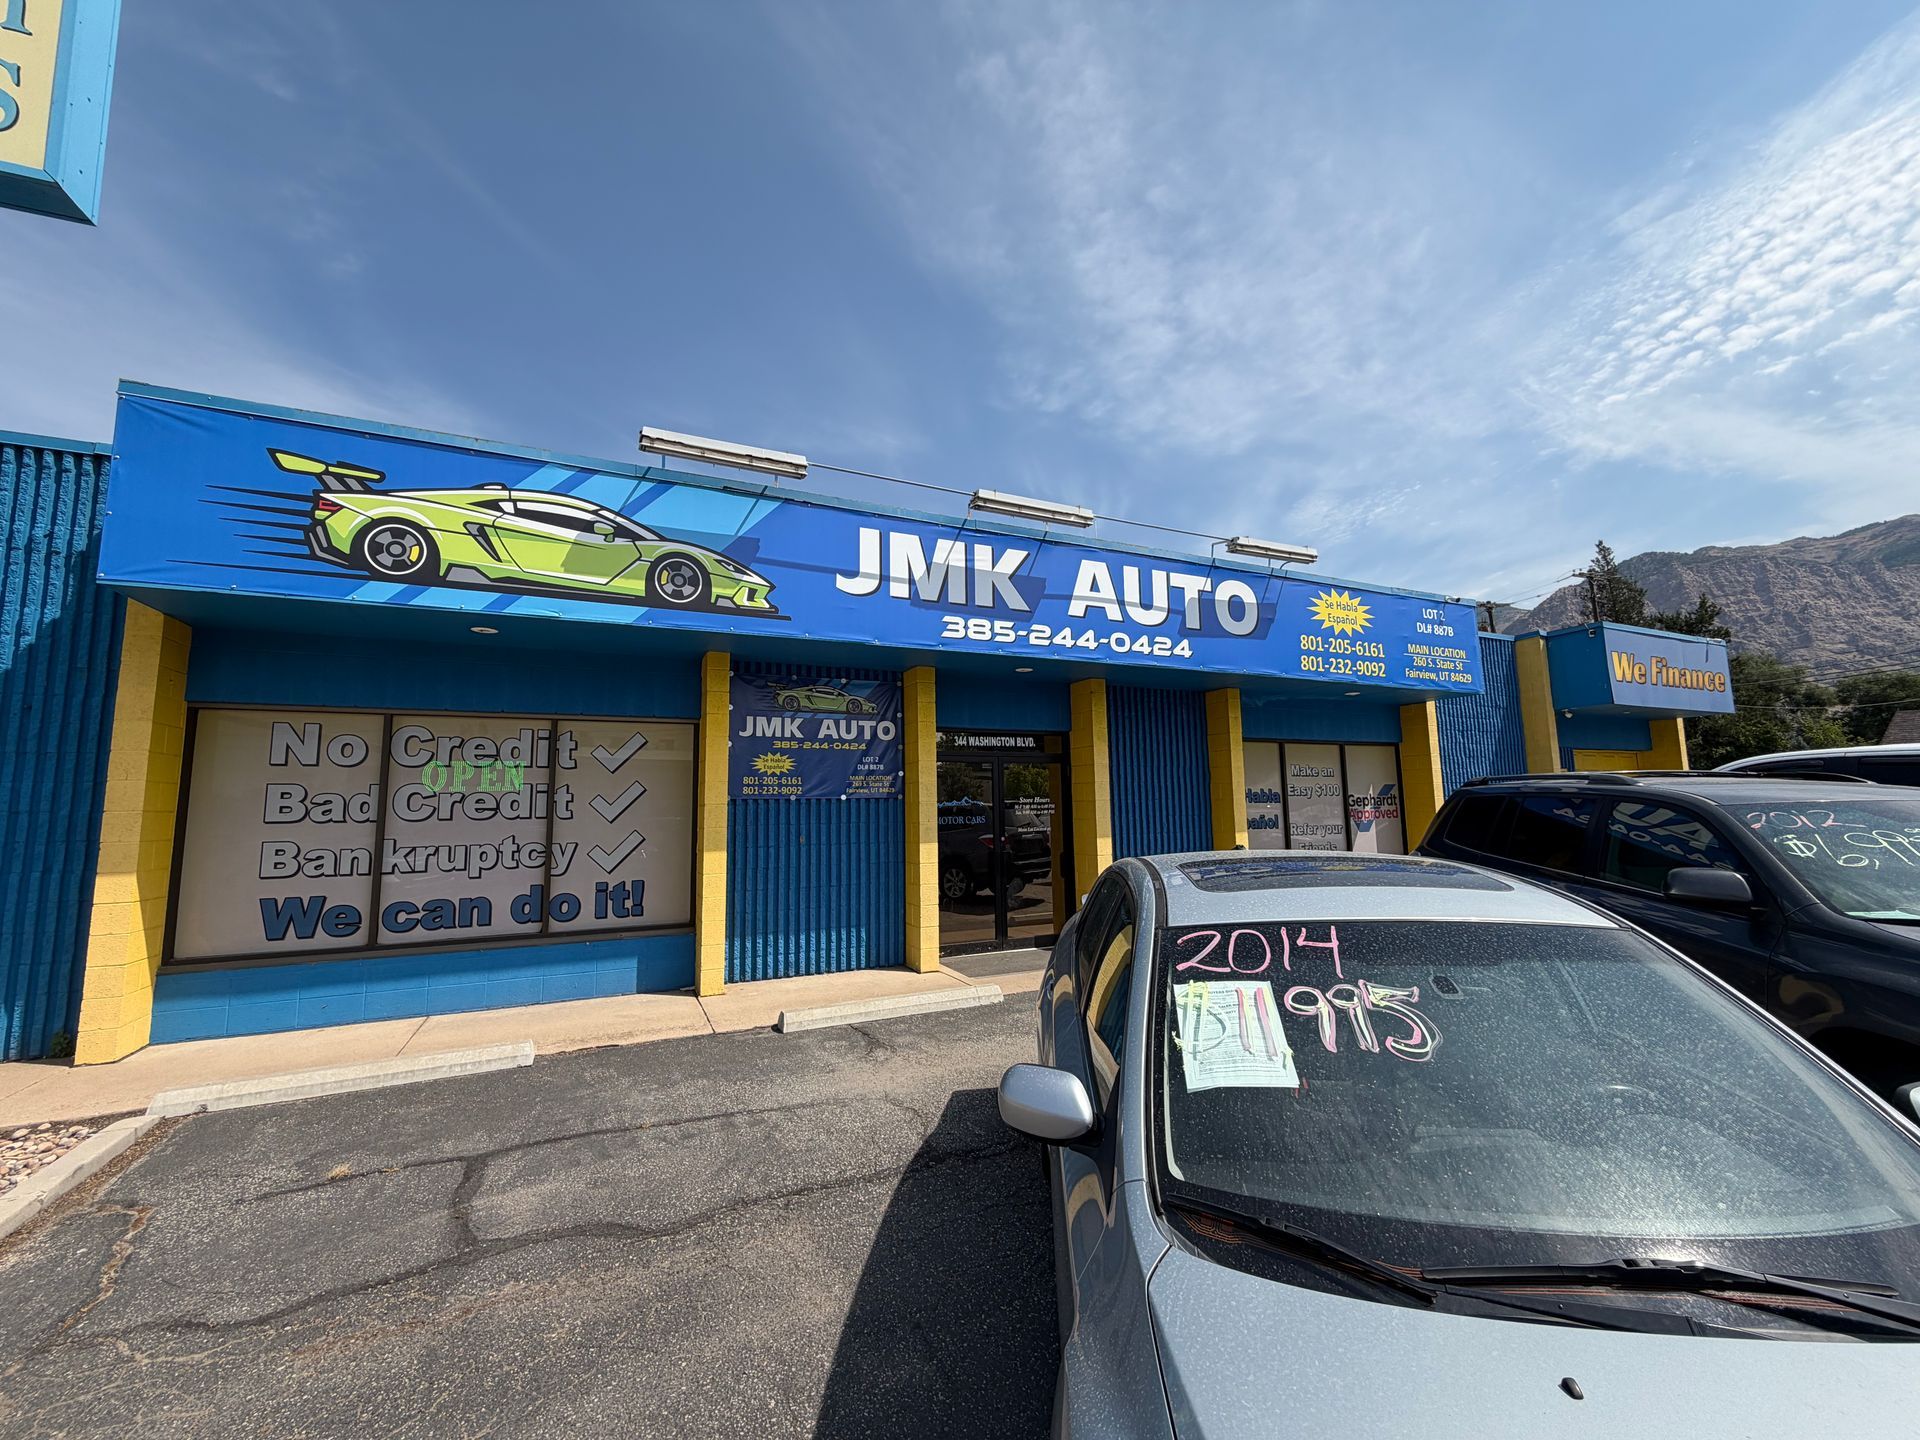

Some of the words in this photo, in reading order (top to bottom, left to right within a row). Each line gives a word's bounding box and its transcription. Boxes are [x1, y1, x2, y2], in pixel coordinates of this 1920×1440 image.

[835, 526, 1031, 613] JMK
[1067, 558, 1259, 637] AUTO
[1324, 599, 1334, 609] Se
[1336, 600, 1358, 613] Habla
[1327, 614, 1358, 626] Español
[1422, 607, 1438, 620] LOT
[1439, 611, 1446, 621] 2
[1416, 622, 1432, 634] DL#
[940, 615, 1194, 658] 385-244-0424
[1300, 634, 1385, 658] 801-205-6161
[1408, 644, 1429, 655] MAIN
[1430, 646, 1466, 659] LOCATION
[1300, 655, 1386, 677] 801-232-9092
[1413, 657, 1426, 666] 260
[1428, 658, 1435, 668] S.
[1436, 660, 1455, 669] State
[1456, 661, 1463, 671] St
[1405, 668, 1438, 681] Fairview,
[1439, 672, 1449, 681] UT
[1611, 651, 1647, 684] We
[1650, 656, 1726, 693] Finance
[739, 716, 804, 738] JMK
[817, 719, 896, 741] AUTO
[269, 721, 370, 768] No
[390, 724, 578, 769] Credit
[773, 740, 868, 750] 385-244-0424
[954, 736, 967, 747] 344
[968, 736, 1015, 747] WASHINGTON
[1016, 737, 1036, 747] BLVD.
[421, 760, 526, 792] OPEN
[1290, 764, 1319, 777] Make
[1321, 767, 1334, 778] an
[743, 777, 802, 785] 801-205-6161
[743, 787, 803, 795] 801-232-9092
[1287, 784, 1313, 799] Easy
[1315, 783, 1341, 797] $100
[263, 783, 380, 825] Bad
[392, 782, 575, 821] Credit
[1348, 794, 1398, 809] Gephardt
[965, 816, 986, 824] CARS
[1247, 814, 1279, 829] añol
[1349, 807, 1399, 821] Approved
[1747, 810, 1868, 829] 2012
[1290, 823, 1319, 836] Refer
[1320, 825, 1344, 837] your
[1774, 827, 1920, 870] $6,99
[259, 835, 579, 880] Bankruptcy
[259, 895, 362, 942] We
[382, 895, 493, 933] can
[510, 884, 581, 925] do
[594, 879, 645, 919] it!
[1175, 925, 1345, 979] 2014
